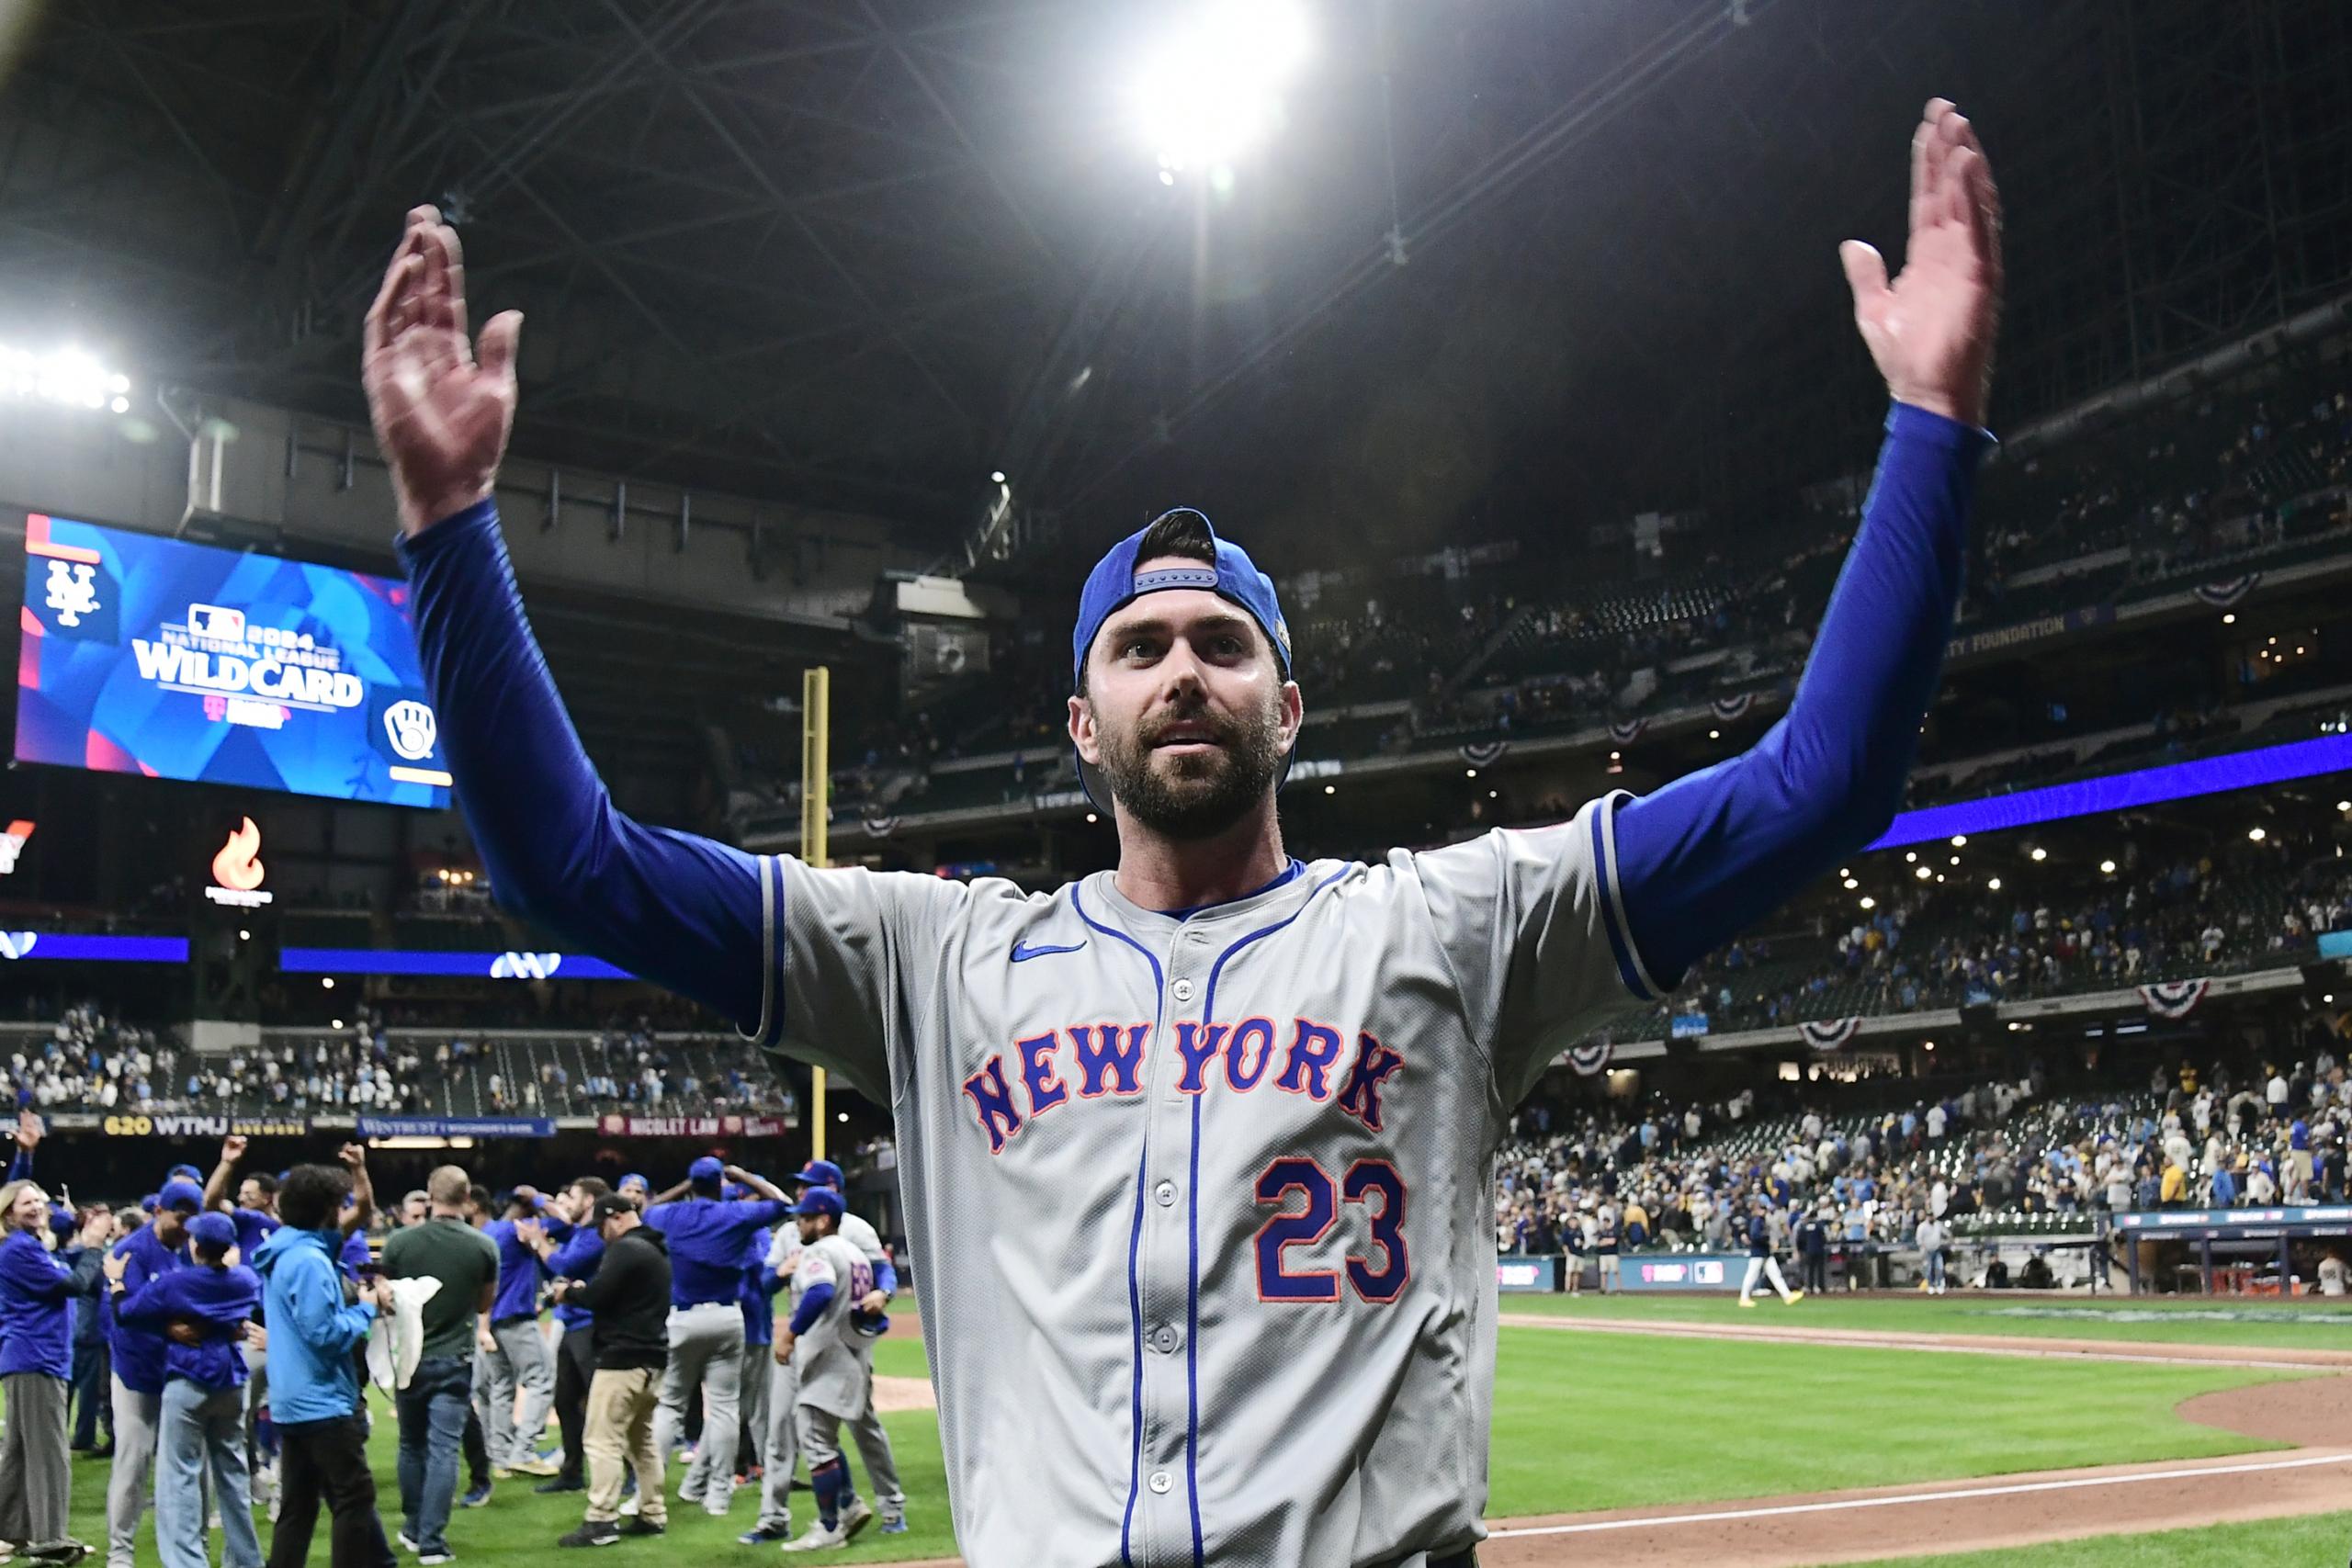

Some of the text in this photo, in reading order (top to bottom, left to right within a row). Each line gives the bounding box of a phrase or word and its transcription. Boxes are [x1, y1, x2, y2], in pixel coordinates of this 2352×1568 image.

[161, 630, 341, 671] NATIONAL LEAGUE
[246, 625, 315, 650] 2024
[1972, 615, 2065, 652] FOUNDATION
[962, 1016, 1406, 1156] NEW YORK
[104, 1115, 229, 1136] 620 WTMJ
[628, 1117, 719, 1136] NICOLET LAW
[1254, 1156, 1410, 1304] 23
